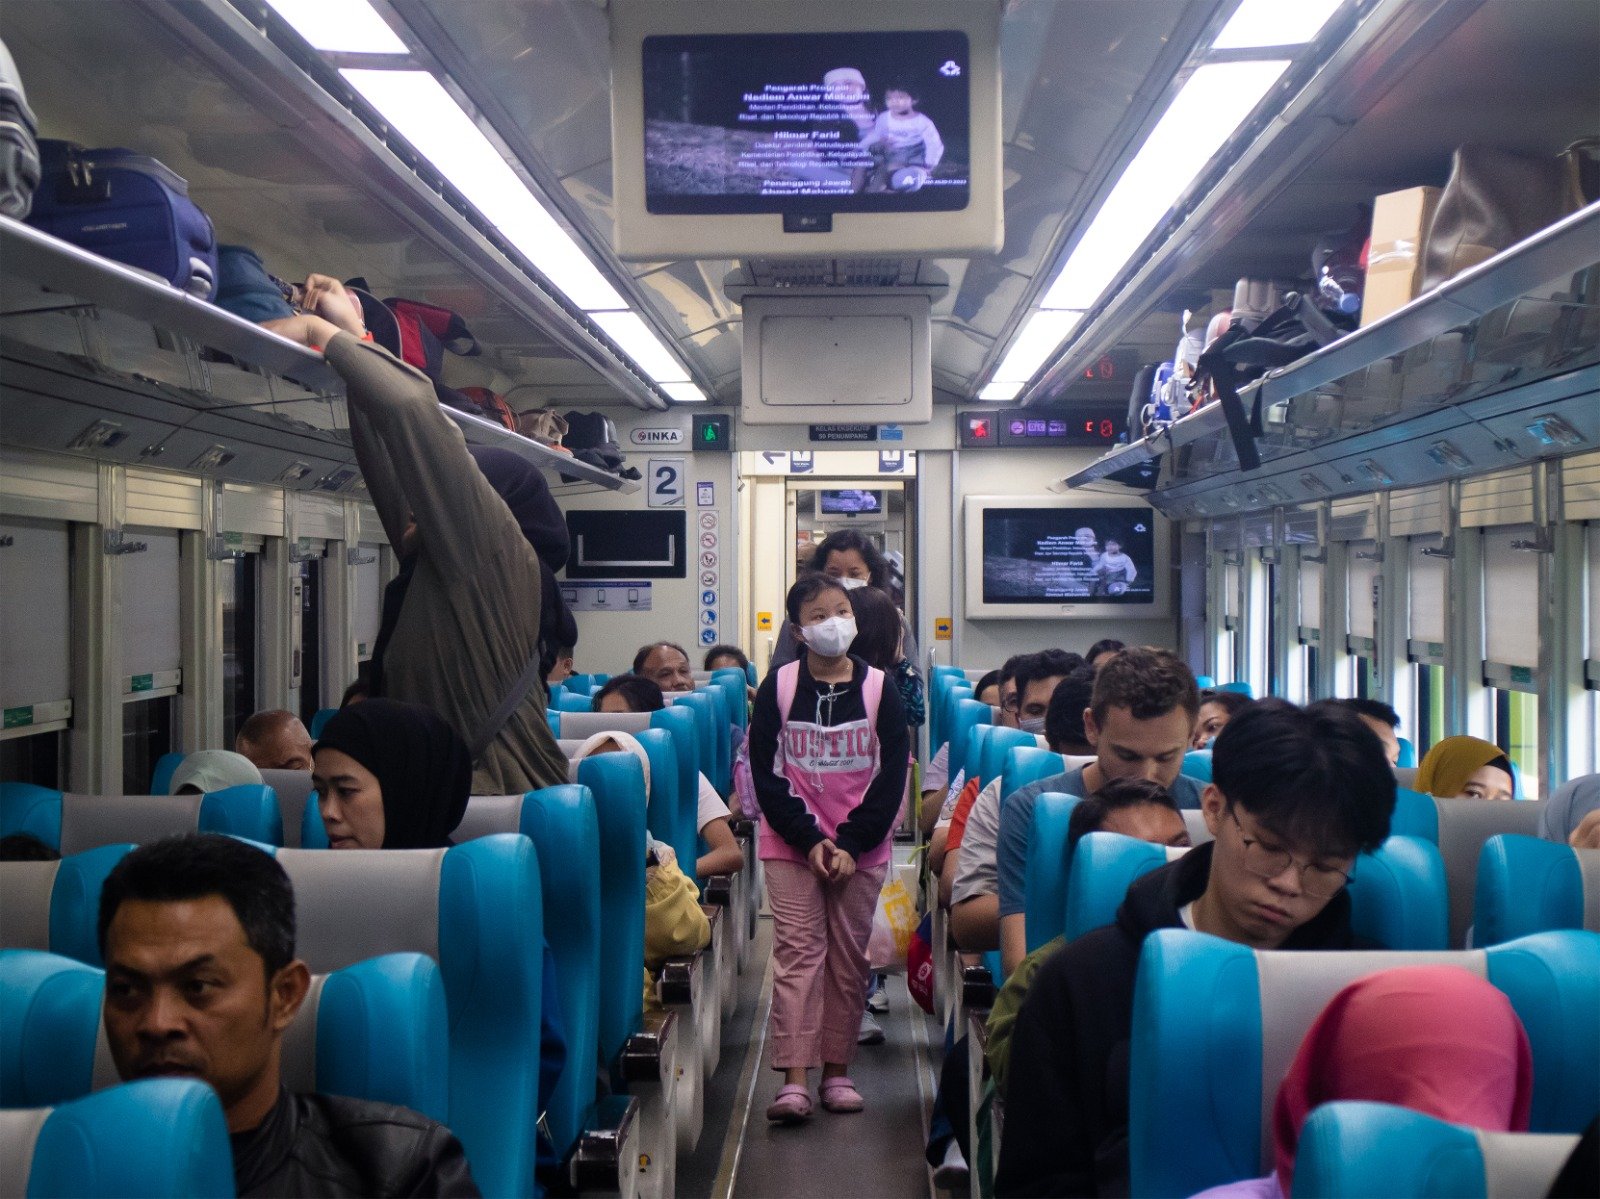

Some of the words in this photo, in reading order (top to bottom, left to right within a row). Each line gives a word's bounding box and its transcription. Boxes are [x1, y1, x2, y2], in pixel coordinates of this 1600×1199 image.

[743, 93, 785, 101] Nadiem
[787, 93, 821, 101] Anwar
[773, 131, 809, 139] Hilmar
[811, 131, 840, 139] Farid
[763, 180, 821, 188] Penanggung
[648, 431, 678, 441] INKA
[655, 466, 677, 495] 2
[790, 727, 876, 759] USTIC
